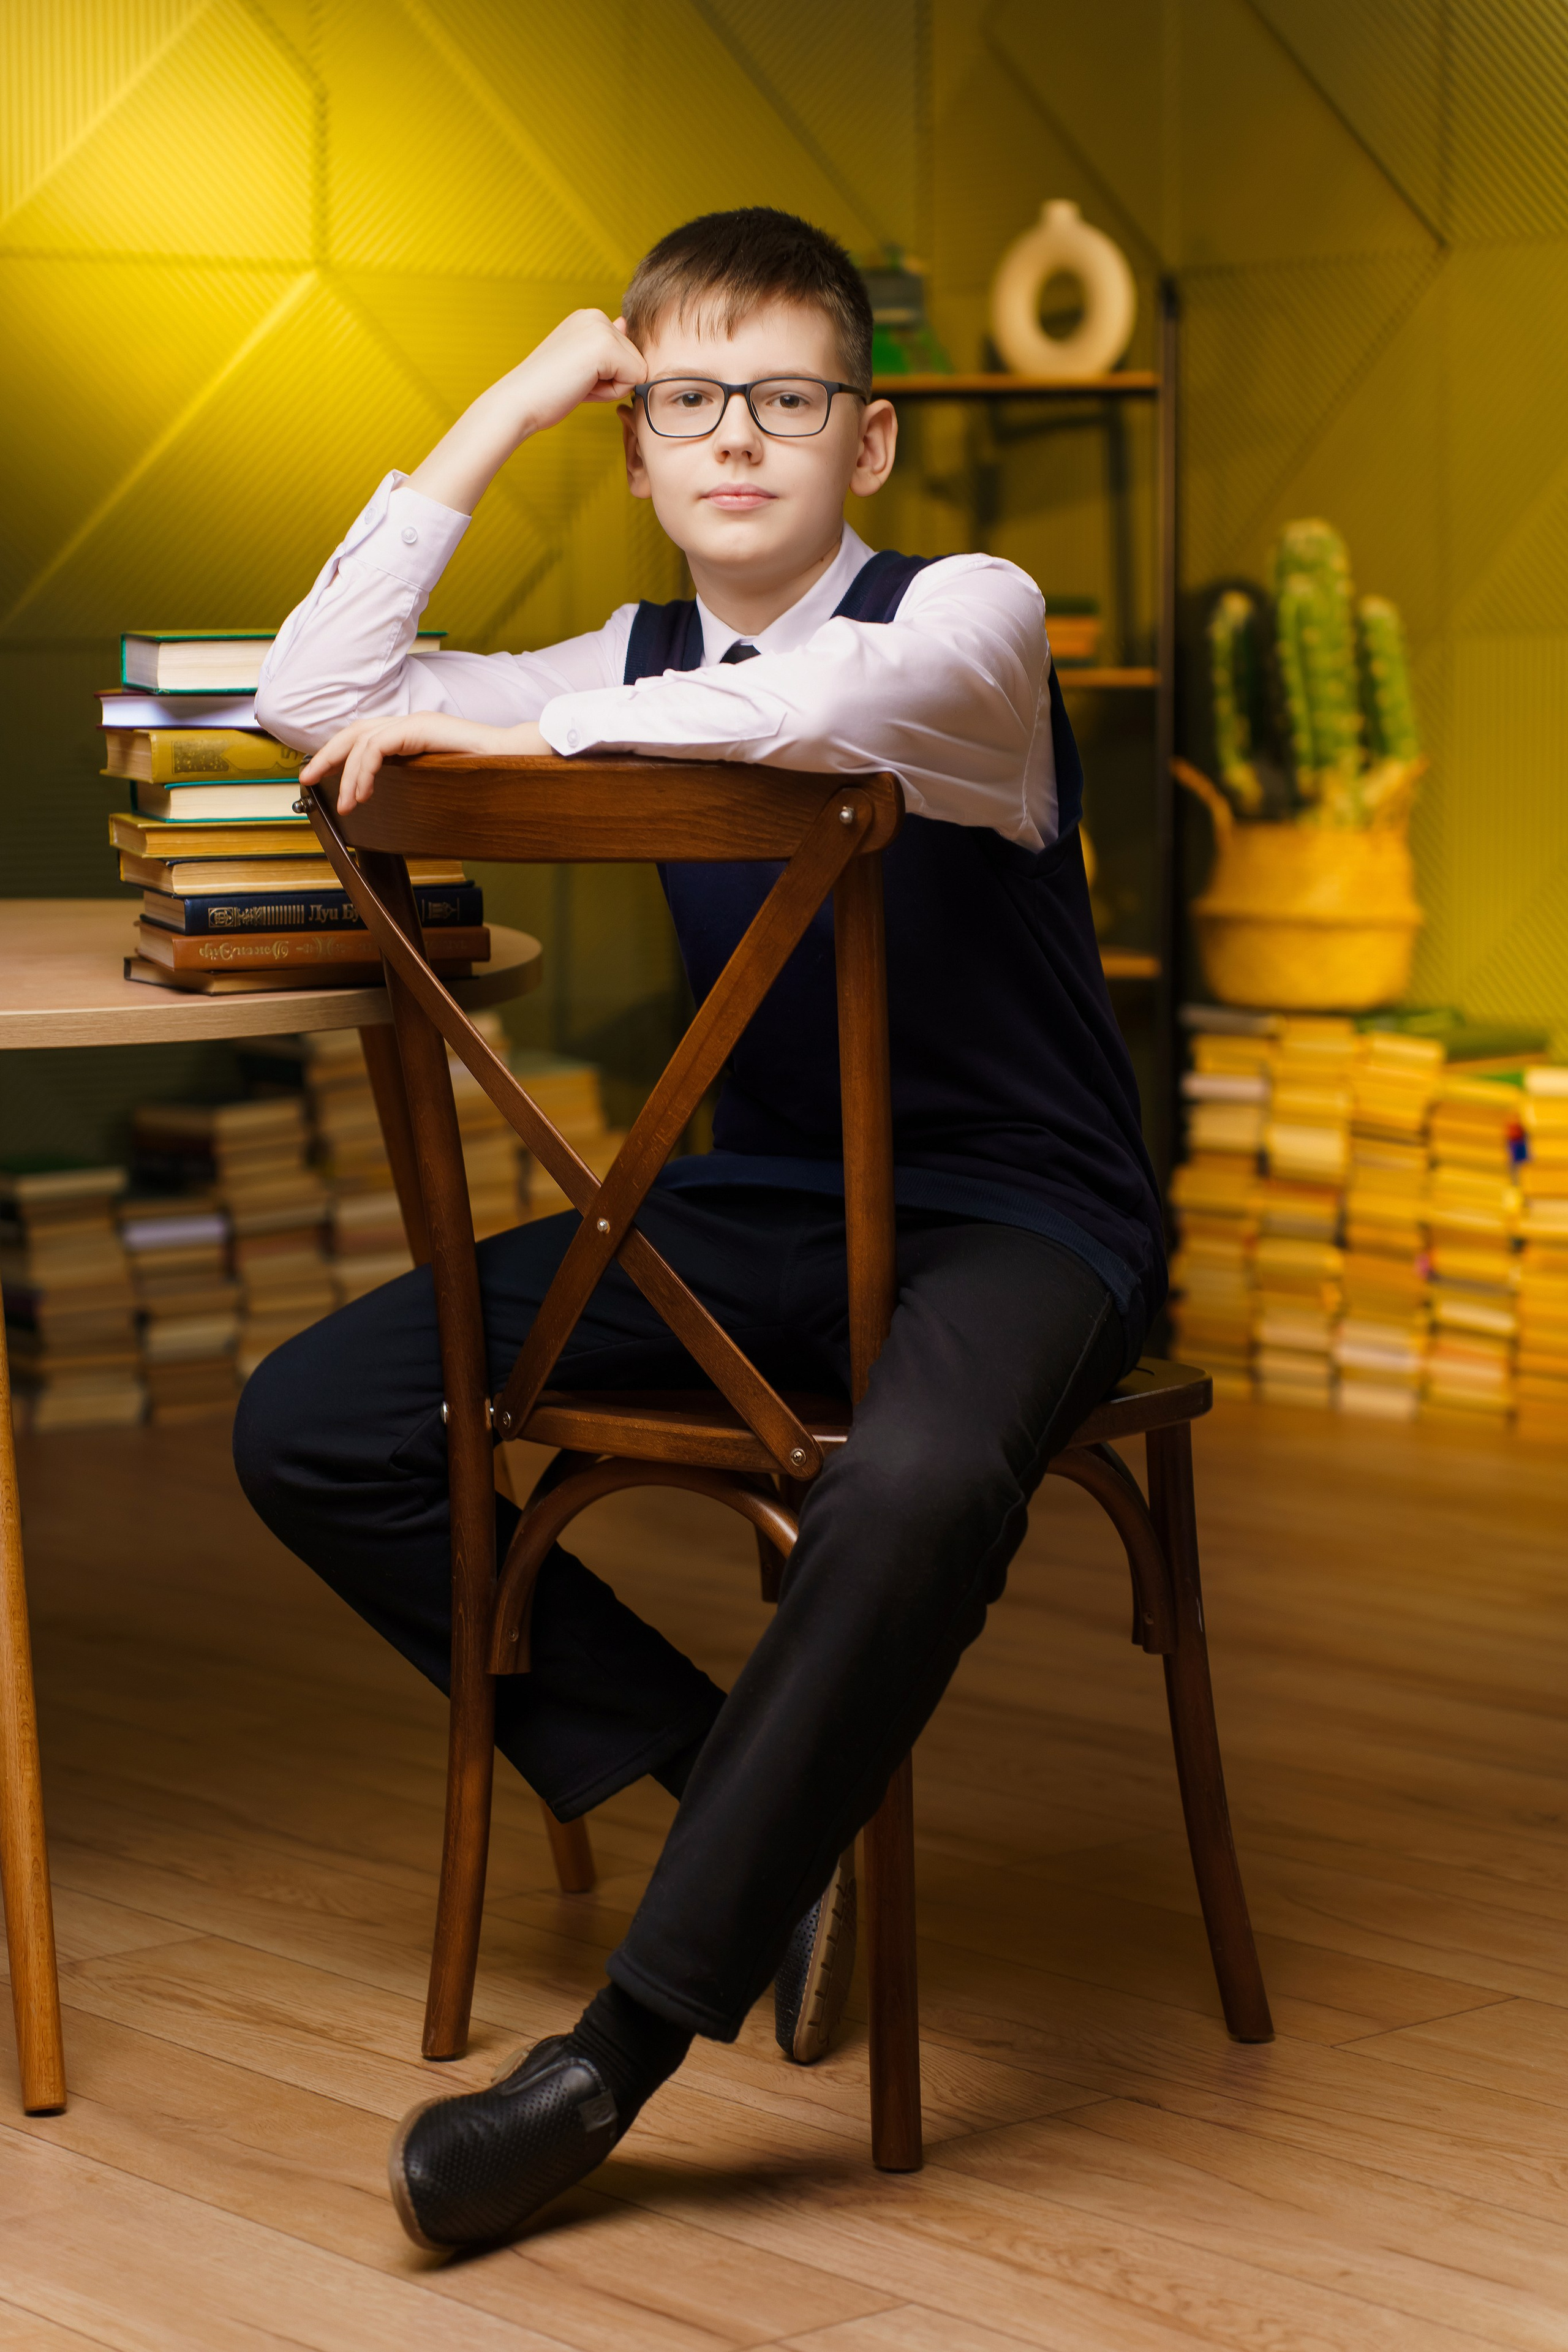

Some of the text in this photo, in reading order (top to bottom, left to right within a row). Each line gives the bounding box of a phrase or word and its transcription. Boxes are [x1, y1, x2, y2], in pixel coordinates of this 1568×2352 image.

[309, 903, 359, 923] Луи Бу
[199, 940, 289, 960] Джен Эйр
